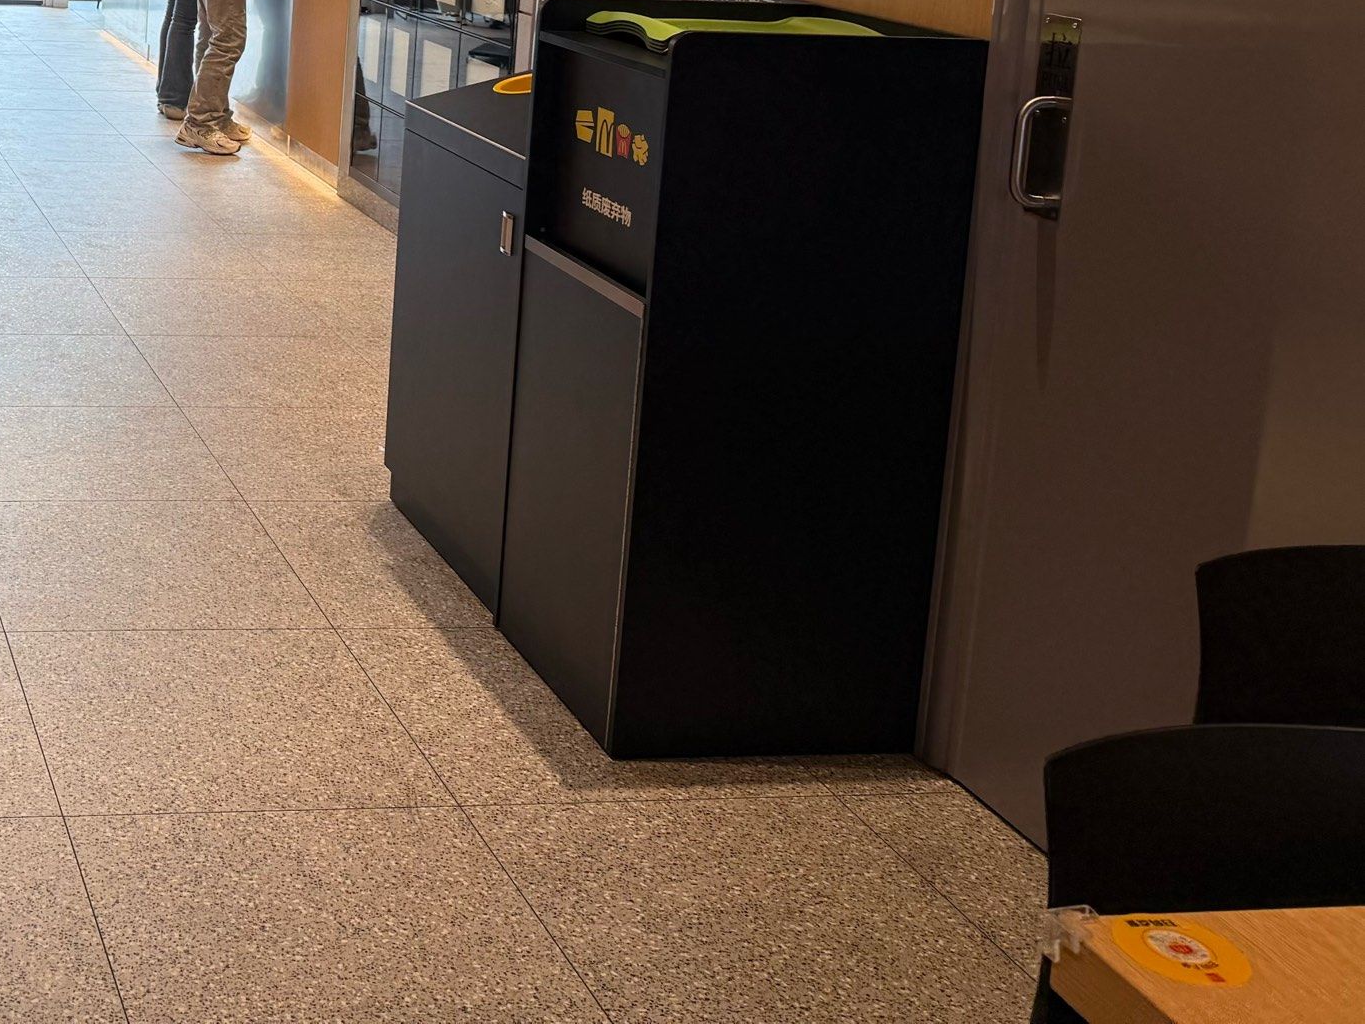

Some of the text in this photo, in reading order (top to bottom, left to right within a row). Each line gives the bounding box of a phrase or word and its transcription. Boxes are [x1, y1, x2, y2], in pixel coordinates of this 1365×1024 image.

[582, 187, 632, 227] 纸质废弃物
